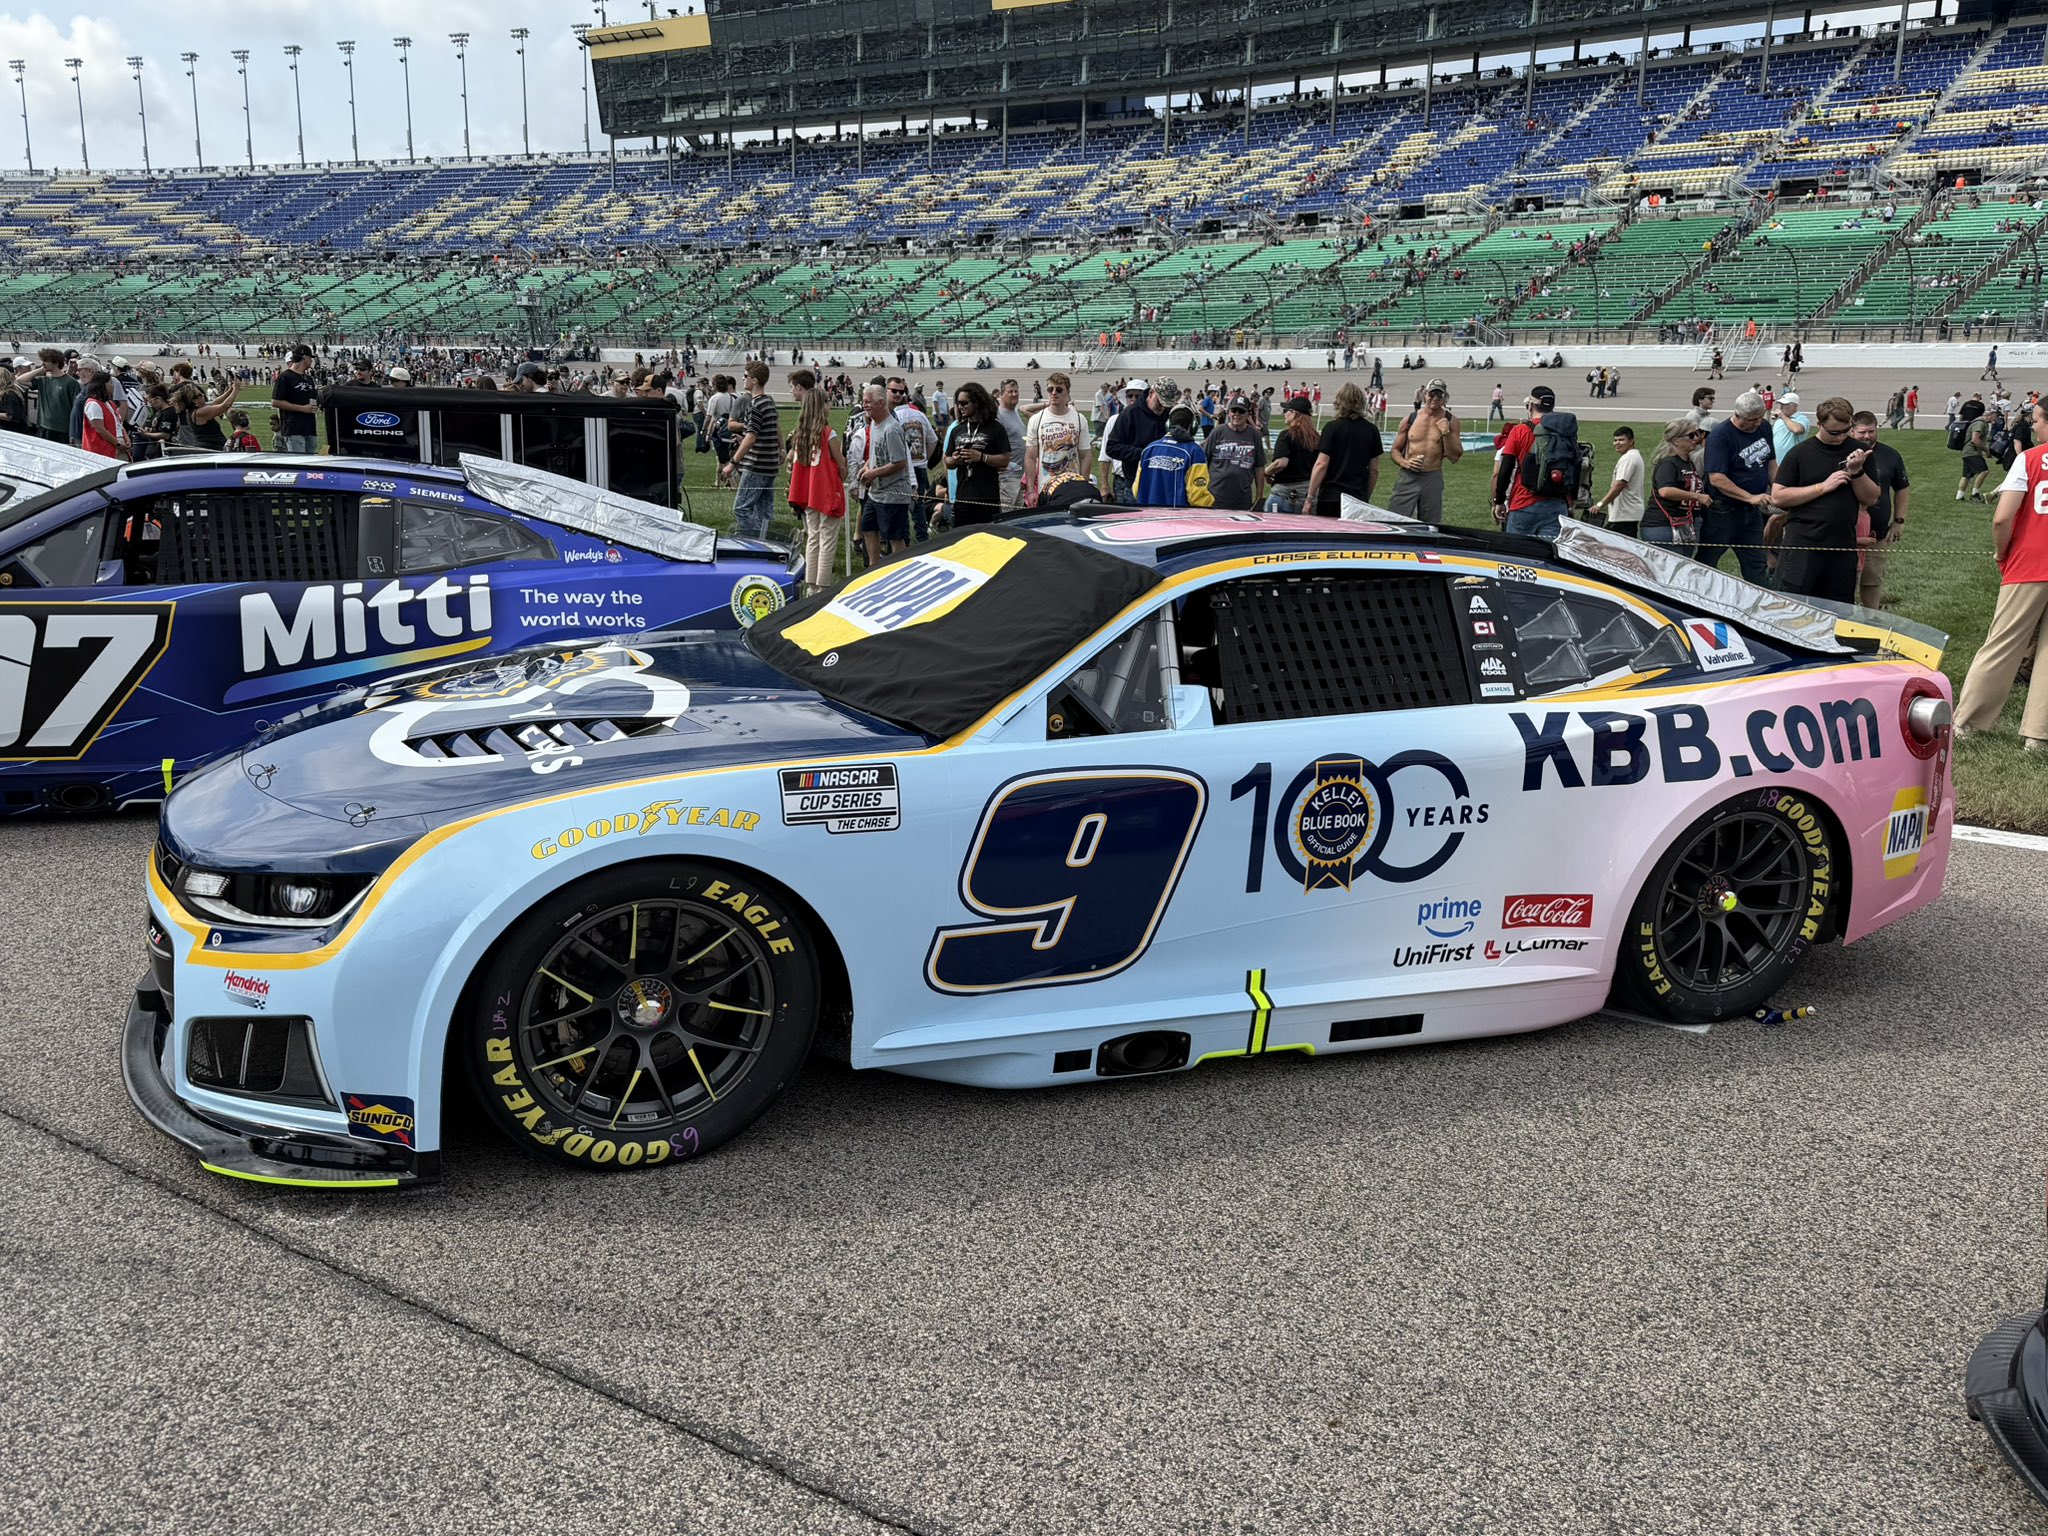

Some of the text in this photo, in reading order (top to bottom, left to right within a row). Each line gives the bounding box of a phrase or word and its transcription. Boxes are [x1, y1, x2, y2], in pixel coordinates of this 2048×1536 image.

[364, 413, 392, 425] Ford
[243, 471, 300, 482] SVG
[409, 487, 465, 503] SIEMENS
[564, 548, 603, 564] Wendy's
[1253, 551, 1411, 565] CHASE ELLIOTT
[520, 589, 643, 608] The way the
[837, 560, 972, 630] NAPA
[240, 574, 492, 673] Mitti
[520, 612, 646, 628] world works
[1473, 621, 1496, 635] CI
[1480, 657, 1506, 670] MAC
[1704, 652, 1745, 665] Valvoline
[1507, 697, 1882, 792] KBB.com
[818, 769, 880, 788] NASCAR
[800, 792, 883, 811] CUP SERIES
[1311, 786, 1364, 811] KELLEY
[837, 816, 892, 831] THE CHASE
[1301, 812, 1367, 831] BLUE BOOK
[1406, 803, 1490, 828] YEARS
[530, 799, 761, 860] GOODYEAR
[1886, 810, 1925, 856] NAPA
[1306, 831, 1359, 855] OFFICIAL GUIDE
[1775, 794, 1832, 942] GOODYEAR
[923, 764, 1210, 997] 9
[700, 879, 796, 956] EAGLE
[1417, 896, 1482, 926] prime
[1392, 942, 1475, 968] UniFirst
[1640, 922, 1672, 996] EAGLE
[223, 969, 270, 995] Hendrick
[485, 1035, 671, 1166] GOODYEAR
[350, 1111, 413, 1129] SUNOCO
